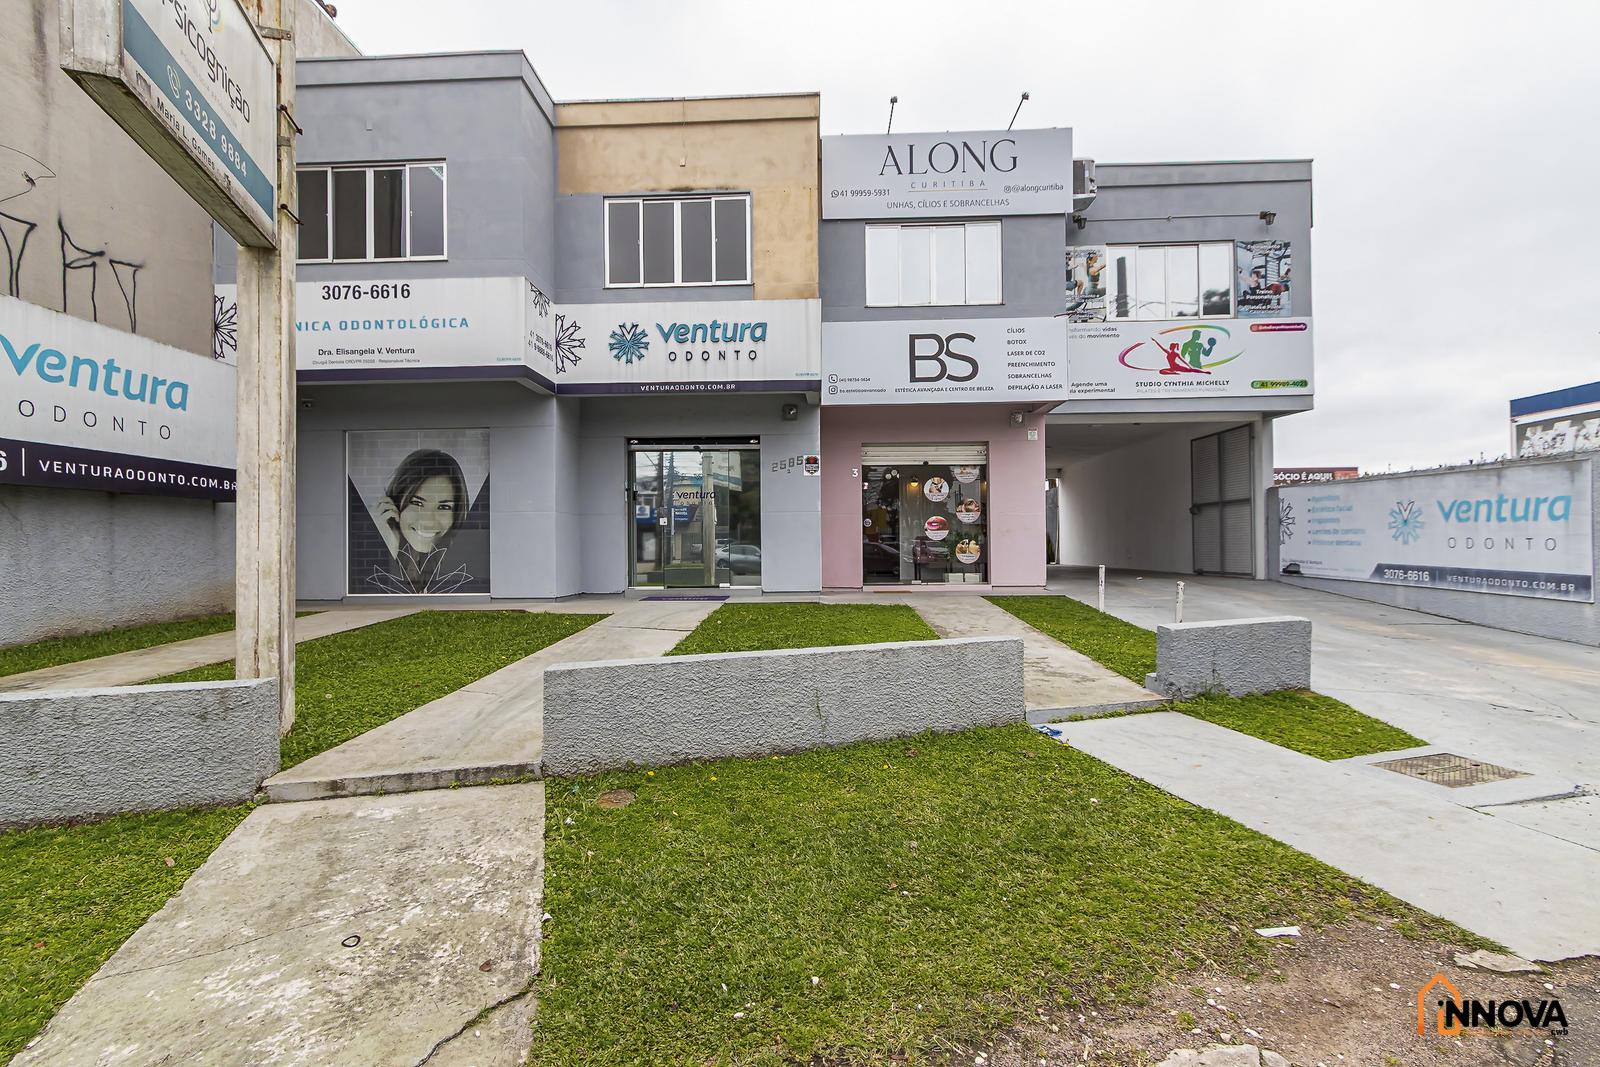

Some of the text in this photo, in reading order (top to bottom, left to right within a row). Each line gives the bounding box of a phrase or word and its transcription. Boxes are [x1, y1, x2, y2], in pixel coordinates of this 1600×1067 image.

[162, 0, 250, 123] sicognição
[156, 96, 180, 132] Maria
[192, 138, 215, 170] Gomes
[185, 89, 216, 140] 3328
[220, 134, 246, 176] 9884
[879, 138, 1018, 176] ALONG
[910, 180, 986, 188] CURITIBA
[918, 200, 942, 208] CÍLIOS
[950, 198, 1010, 207] SOBRANCELHAS
[322, 283, 410, 300] 3076-6616
[339, 316, 470, 331] ODONTOLÓGICA
[336, 348, 375, 356] Elisangela
[668, 350, 757, 362] ODONTO
[909, 332, 979, 383] BS
[18, 400, 171, 440] ODONTO
[852, 468, 858, 477] 3
[1448, 537, 1557, 551] ODONTO
[1384, 568, 1575, 592] 3076-6616 VENTURAODONTO.COM.BR
